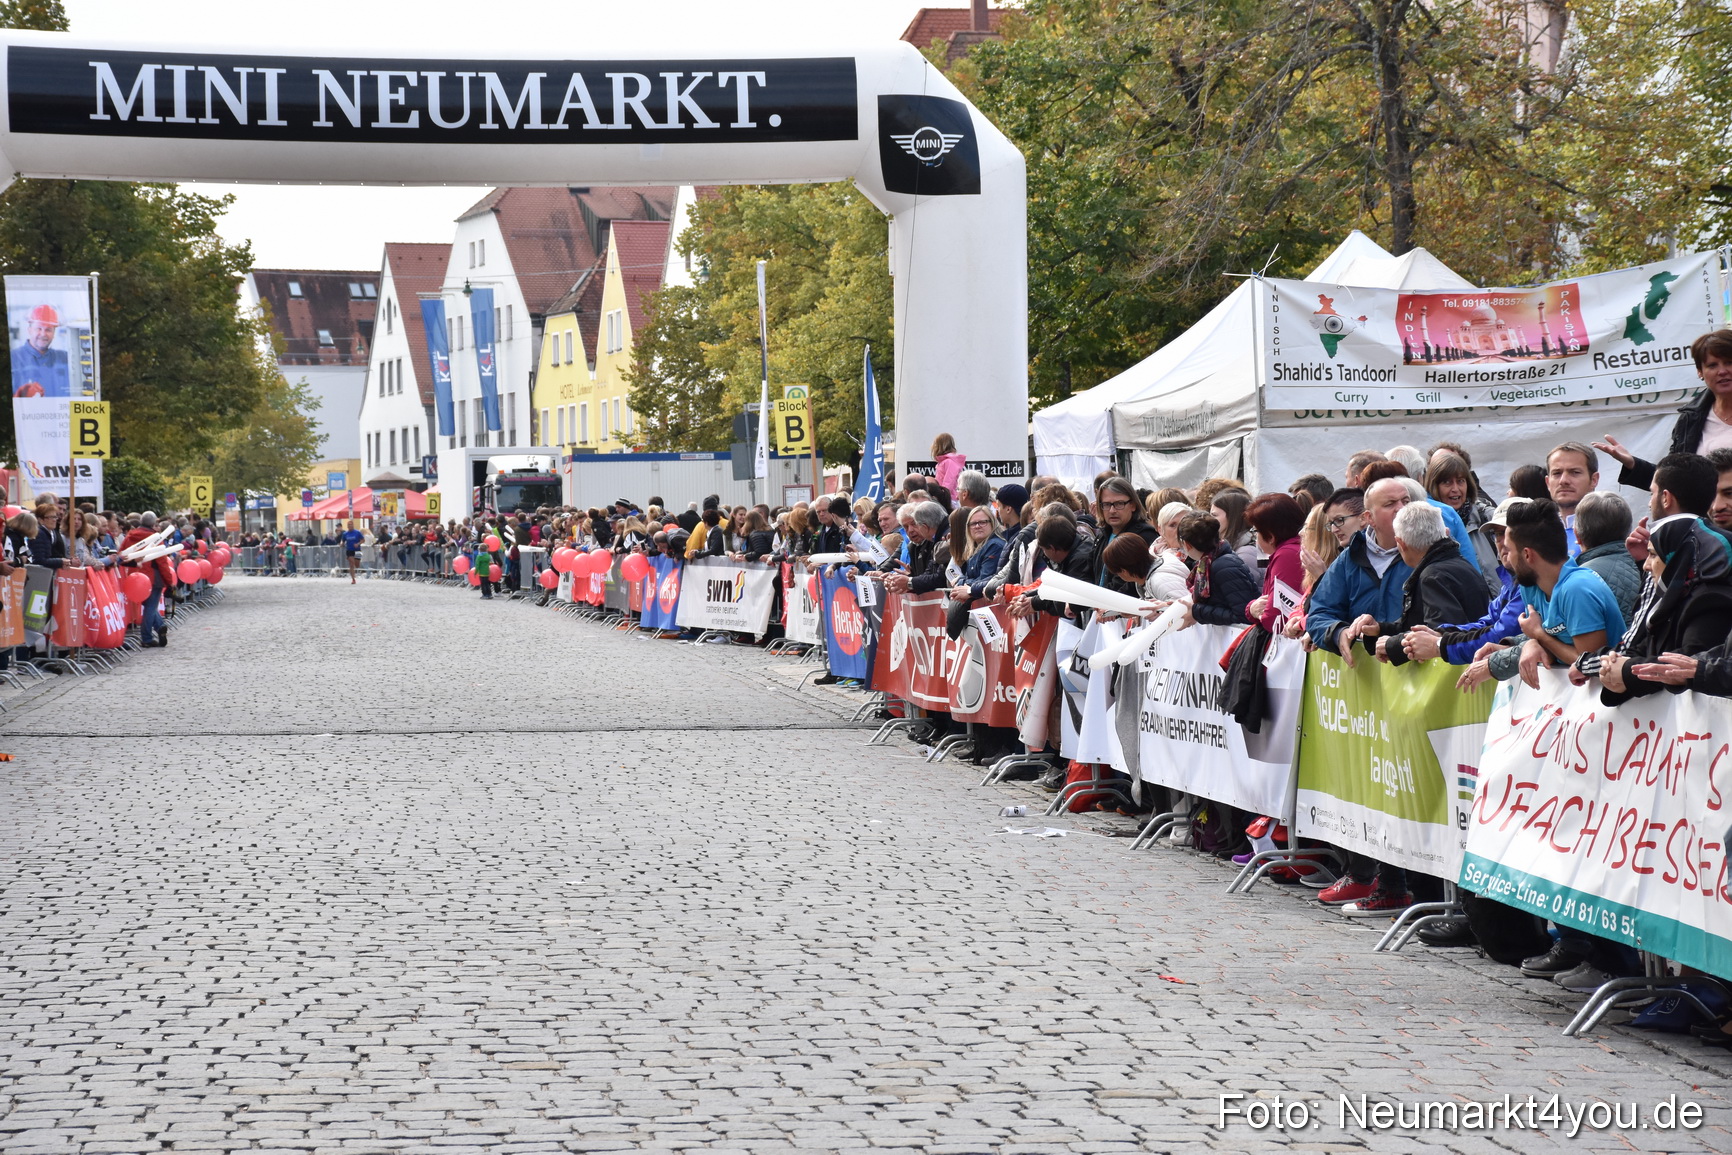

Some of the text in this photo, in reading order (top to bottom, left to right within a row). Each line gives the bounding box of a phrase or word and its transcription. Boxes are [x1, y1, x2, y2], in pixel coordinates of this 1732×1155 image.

[89, 61, 782, 129] MINI NEUMARKT.
[916, 139, 941, 149] MINI
[1443, 299, 1460, 308] Tel.
[1272, 285, 1280, 356] INDISCH
[1560, 290, 1581, 352] PAKISTAN
[1404, 301, 1421, 359] INDIEN
[1593, 344, 1694, 371] Restauran
[1273, 363, 1397, 382] Shahid's Tandoori
[1425, 362, 1567, 383] Hallertorstraße 21
[560, 384, 574, 399] HOTEL
[1614, 376, 1657, 390] Vegan
[1334, 391, 1369, 405] Curry
[1415, 392, 1441, 403] Grill
[1490, 385, 1566, 403] Vegetarisch
[74, 403, 105, 414] Block
[778, 401, 807, 412] Block
[80, 418, 100, 446] B
[785, 416, 805, 443] B
[196, 486, 207, 500] C
[430, 499, 438, 510] D
[706, 579, 732, 603] swn
[1279, 591, 1295, 607] wn
[983, 620, 996, 637] swn
[1321, 661, 1341, 689] Der
[1464, 862, 1549, 909] Service-Line:
[1552, 895, 1562, 913] 0
[1602, 910, 1617, 932] 63
